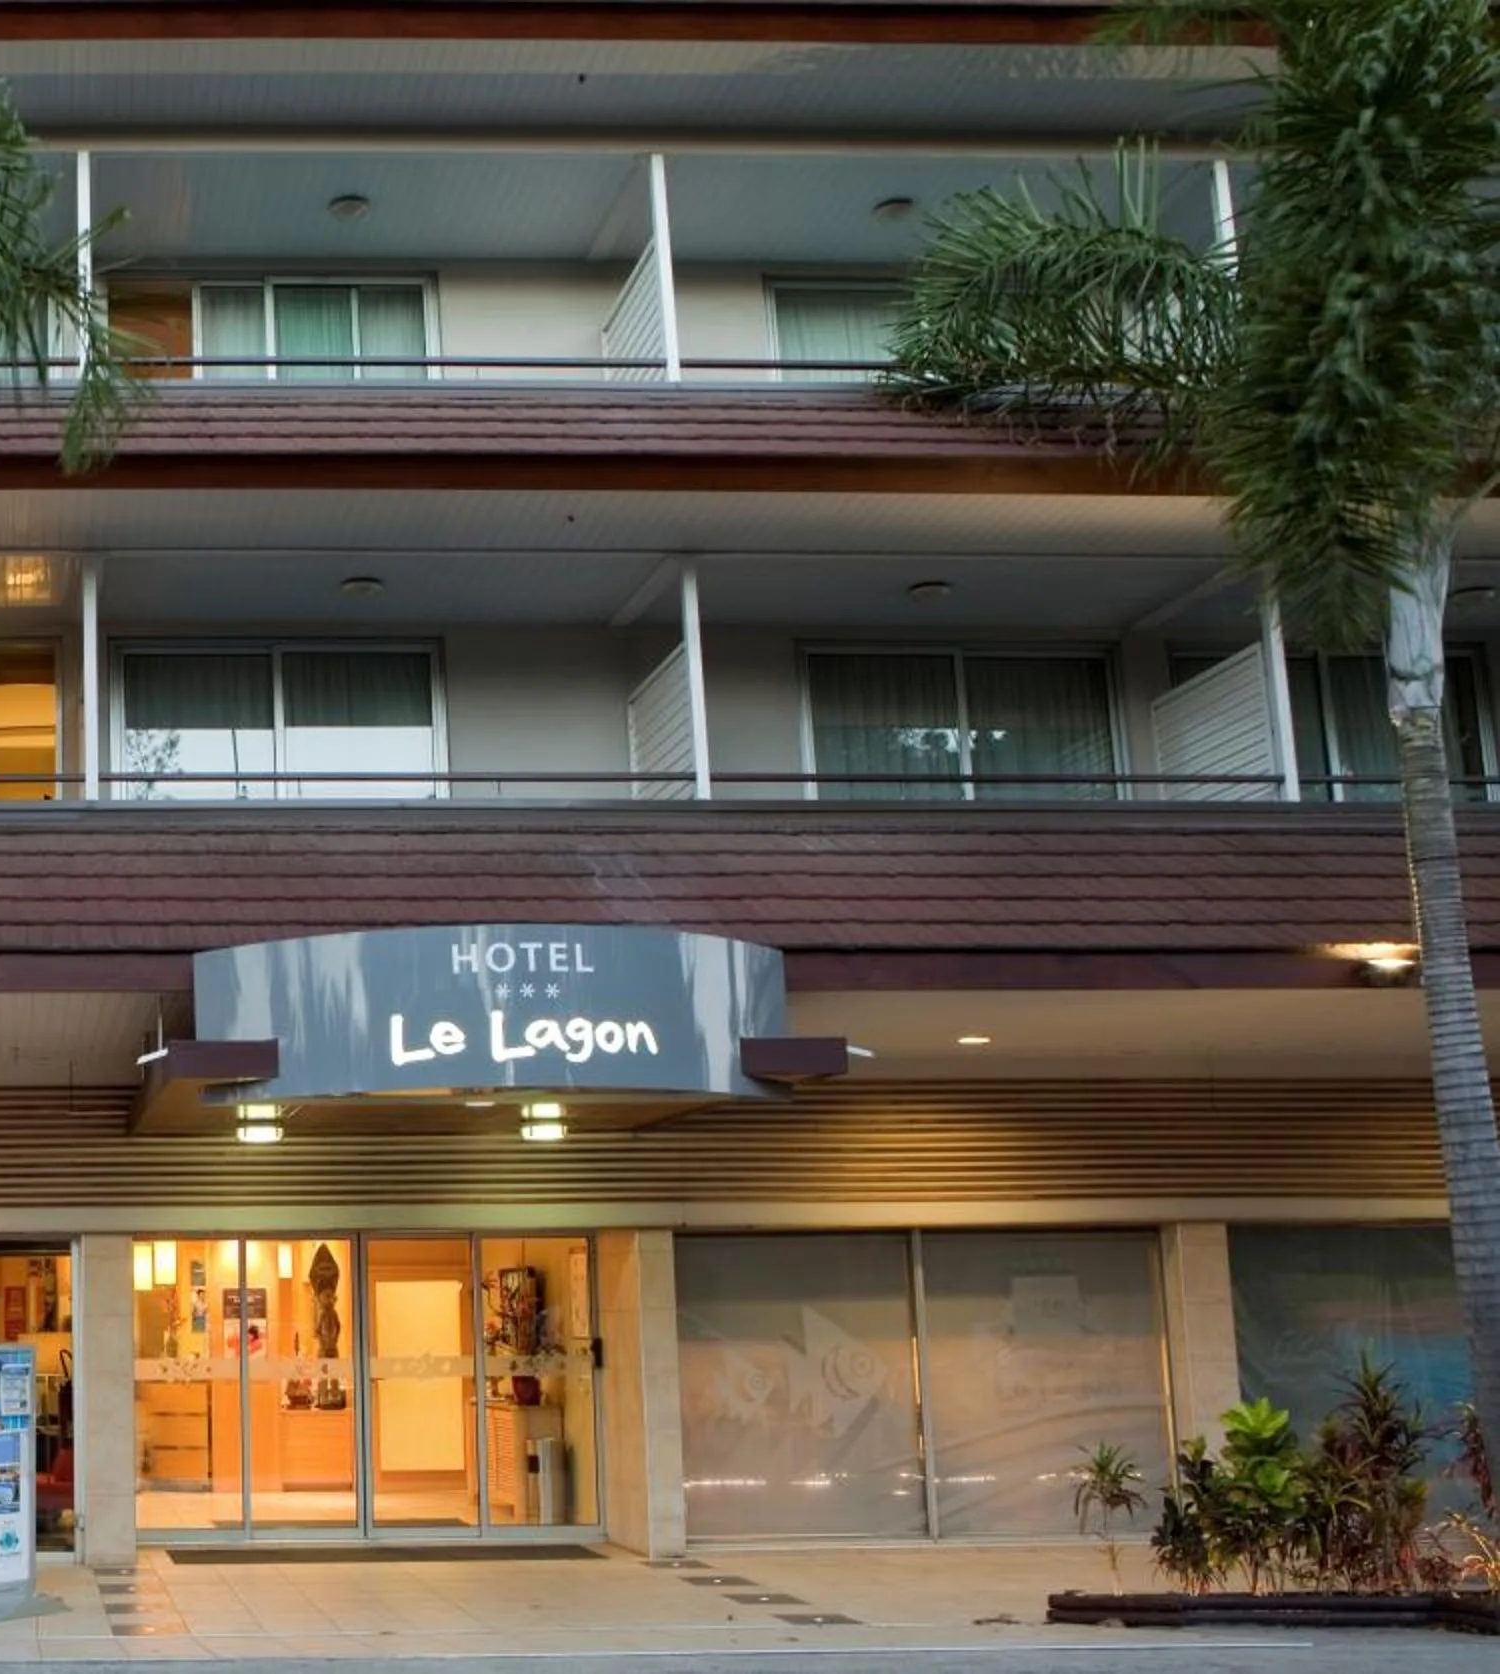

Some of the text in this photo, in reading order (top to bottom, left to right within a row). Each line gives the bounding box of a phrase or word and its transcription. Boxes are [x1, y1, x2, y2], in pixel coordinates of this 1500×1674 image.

[451, 941, 595, 974] HOTEL
[389, 1010, 659, 1066] Le Lagon
